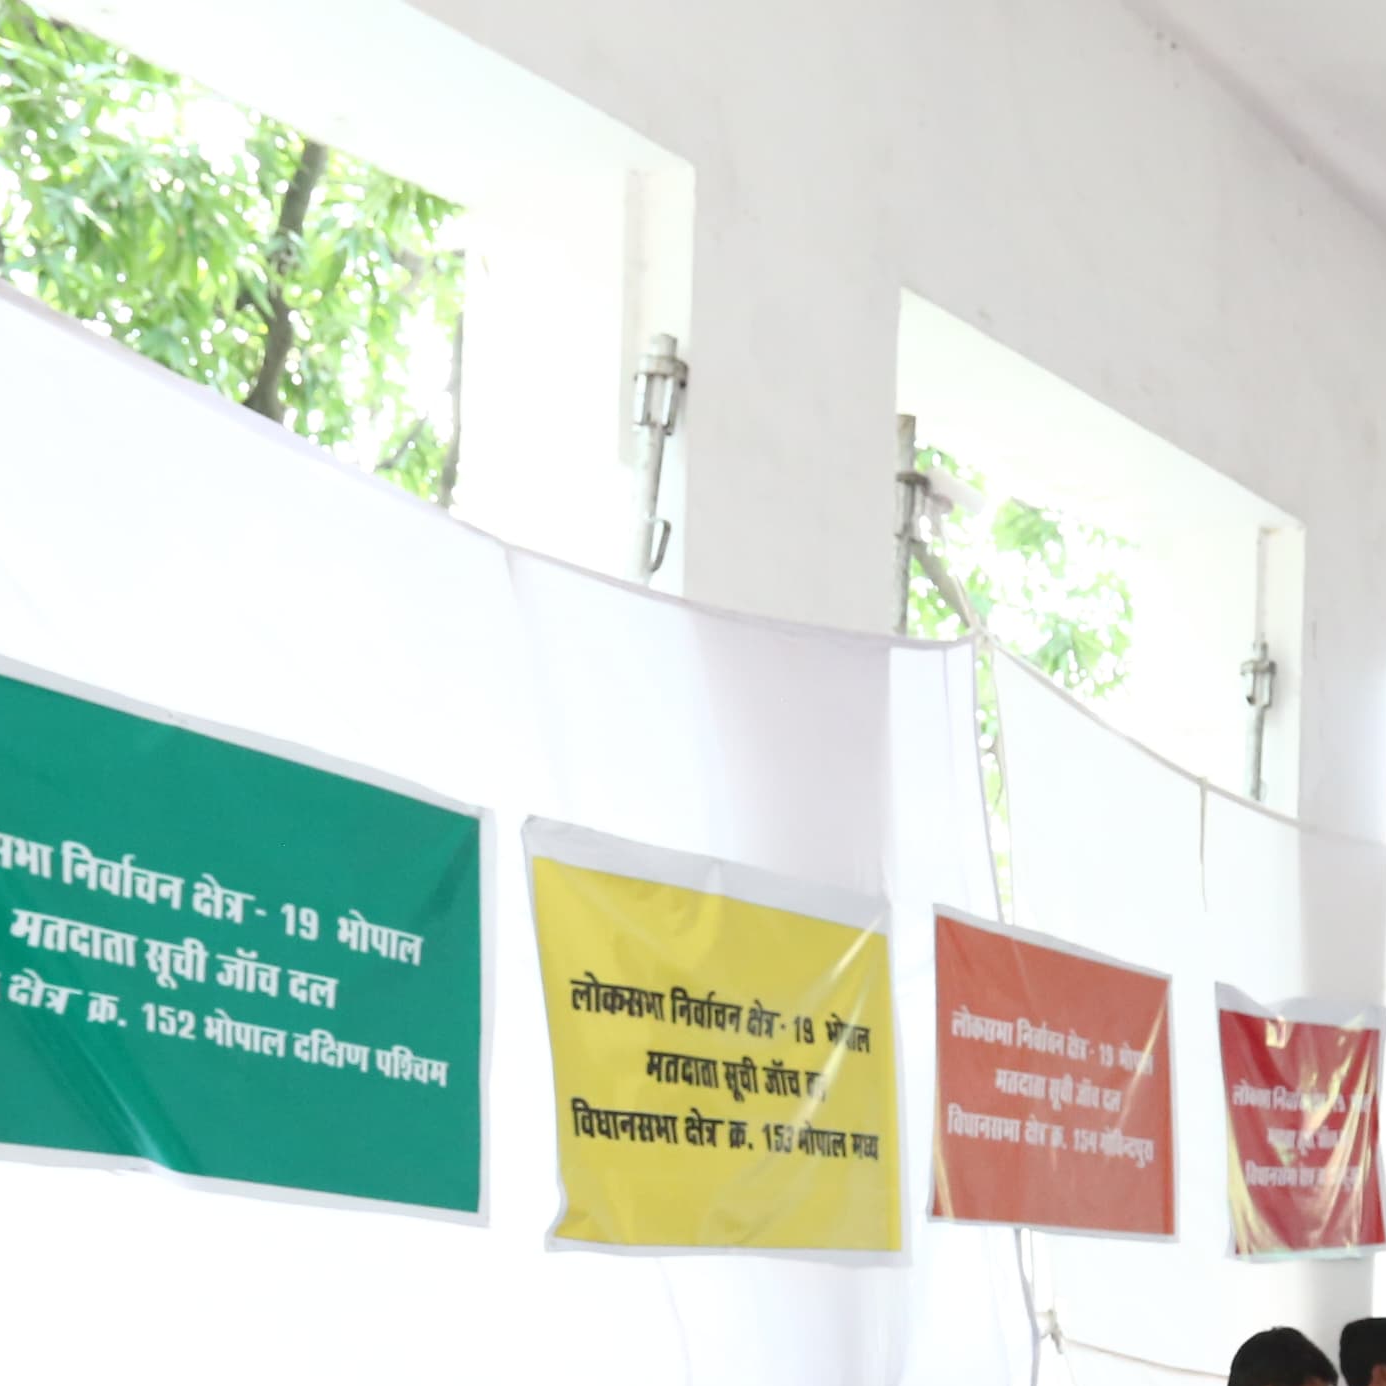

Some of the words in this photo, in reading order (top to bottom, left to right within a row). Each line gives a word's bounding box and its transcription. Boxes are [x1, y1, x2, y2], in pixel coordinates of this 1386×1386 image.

[61, 840, 185, 910] निर्वाचन
[280, 903, 320, 941] 19
[337, 909, 424, 966] भोपाल
[10, 907, 138, 968] मतदाता
[144, 936, 209, 990] सूची
[288, 969, 339, 1010] दल
[8, 967, 82, 1015] क्षेत्र
[86, 990, 127, 1028] क्र.
[142, 1002, 197, 1041] 152
[204, 1008, 288, 1058] भोपाल
[293, 1027, 370, 1073] दक्षिण
[375, 1044, 449, 1088] पश्चिम
[570, 971, 665, 1022] लोकसभा
[671, 985, 742, 1033] निर्वाचन
[794, 1016, 815, 1044] 19
[646, 1050, 718, 1088] मतदाता
[723, 1056, 759, 1102] सूची
[571, 1097, 678, 1144] विधानसभा
[685, 1109, 723, 1148] क्षेत्र
[798, 1120, 847, 1158] भोपाल
